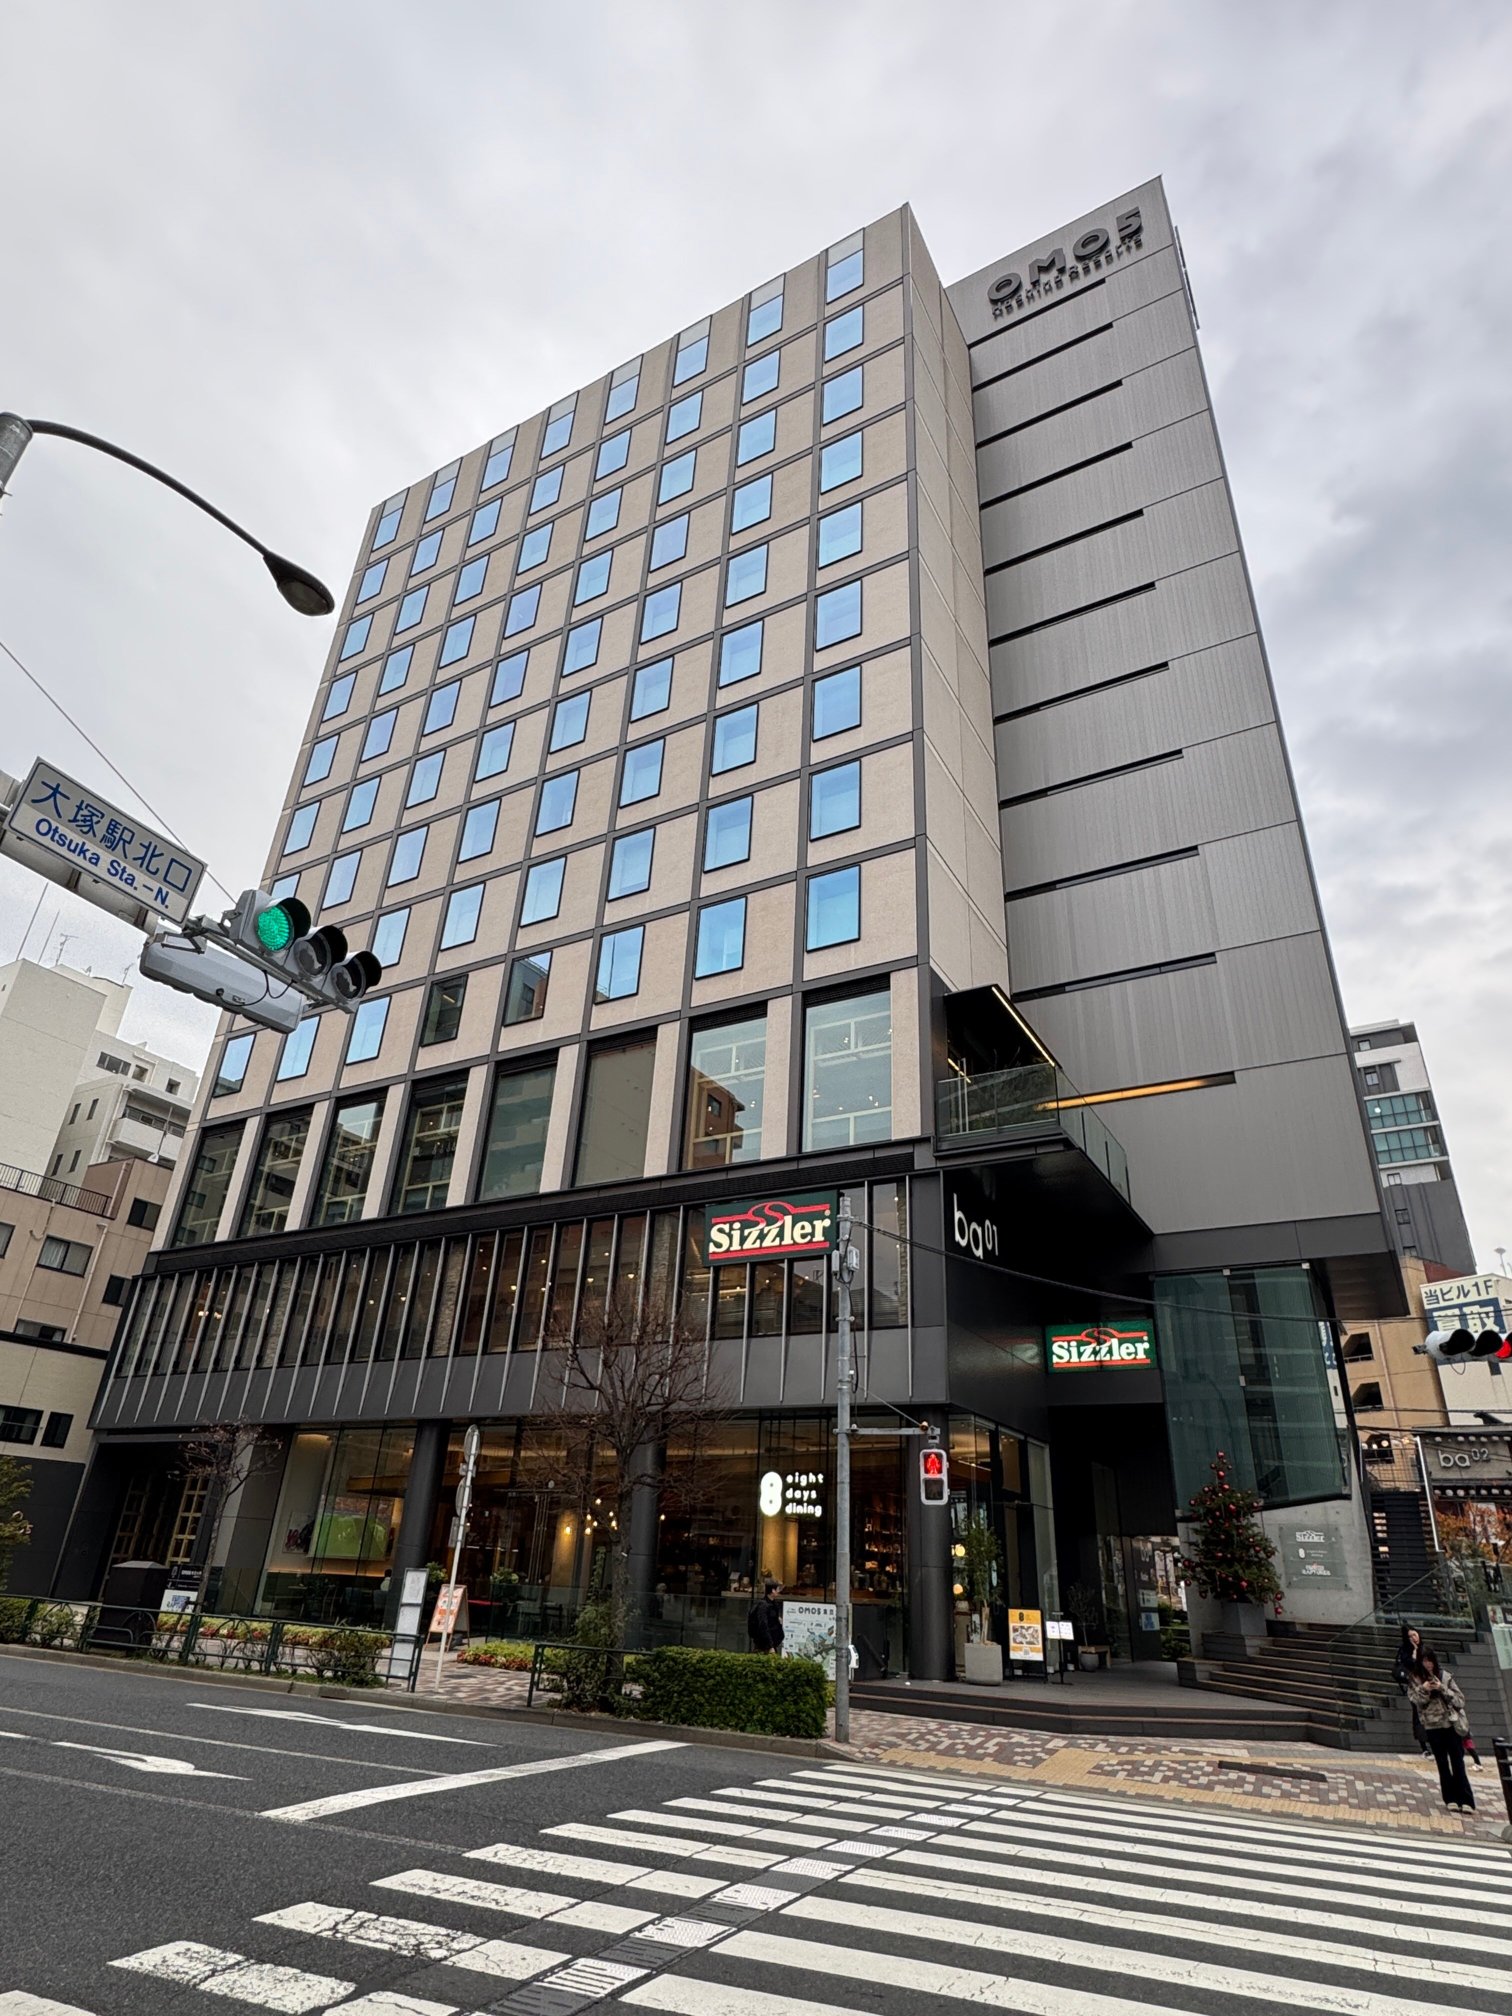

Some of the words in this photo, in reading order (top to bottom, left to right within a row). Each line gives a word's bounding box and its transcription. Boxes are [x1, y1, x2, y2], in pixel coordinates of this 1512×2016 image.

[987, 206, 1143, 304] OMO5
[31, 780, 193, 894] 大塚駅北口
[35, 817, 101, 867] Otsuka
[709, 1210, 831, 1253] Sizzler
[1424, 1279, 1493, 1306] 当ビル1F
[1432, 1305, 1500, 1333] 買取
[1052, 1337, 1150, 1363] Sizzler
[786, 1472, 824, 1487] eight
[785, 1487, 817, 1501] days
[785, 1502, 822, 1517] dining
